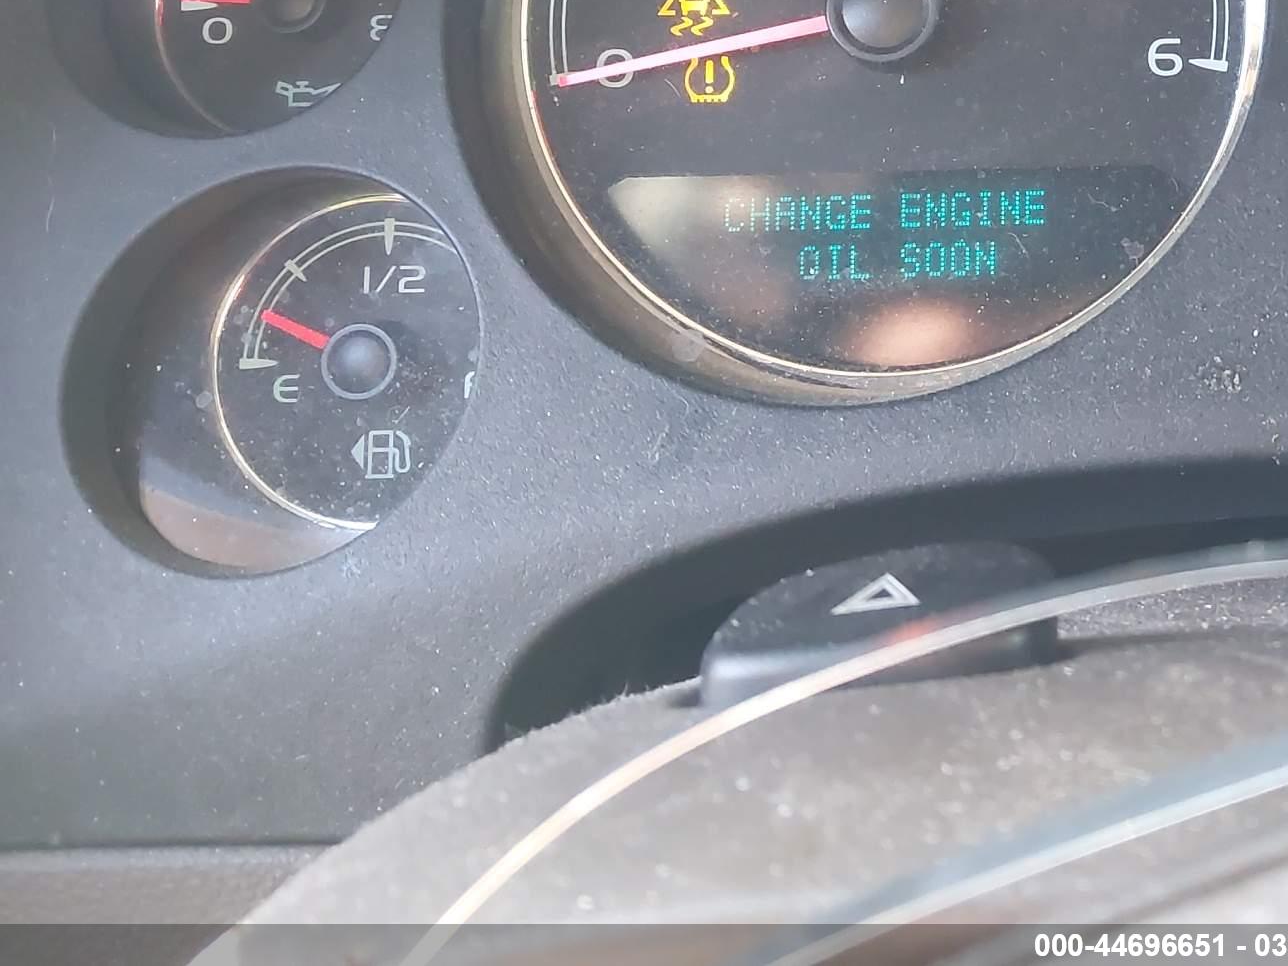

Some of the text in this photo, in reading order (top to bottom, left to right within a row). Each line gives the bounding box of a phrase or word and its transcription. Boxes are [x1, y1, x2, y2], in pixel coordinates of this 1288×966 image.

[202, 17, 233, 44] 0
[597, 49, 635, 88] 0
[1147, 38, 1183, 76] 6
[724, 190, 1046, 232] CHANGE ENGINE
[799, 240, 996, 280] OIL SOON
[363, 265, 426, 294] 1/2
